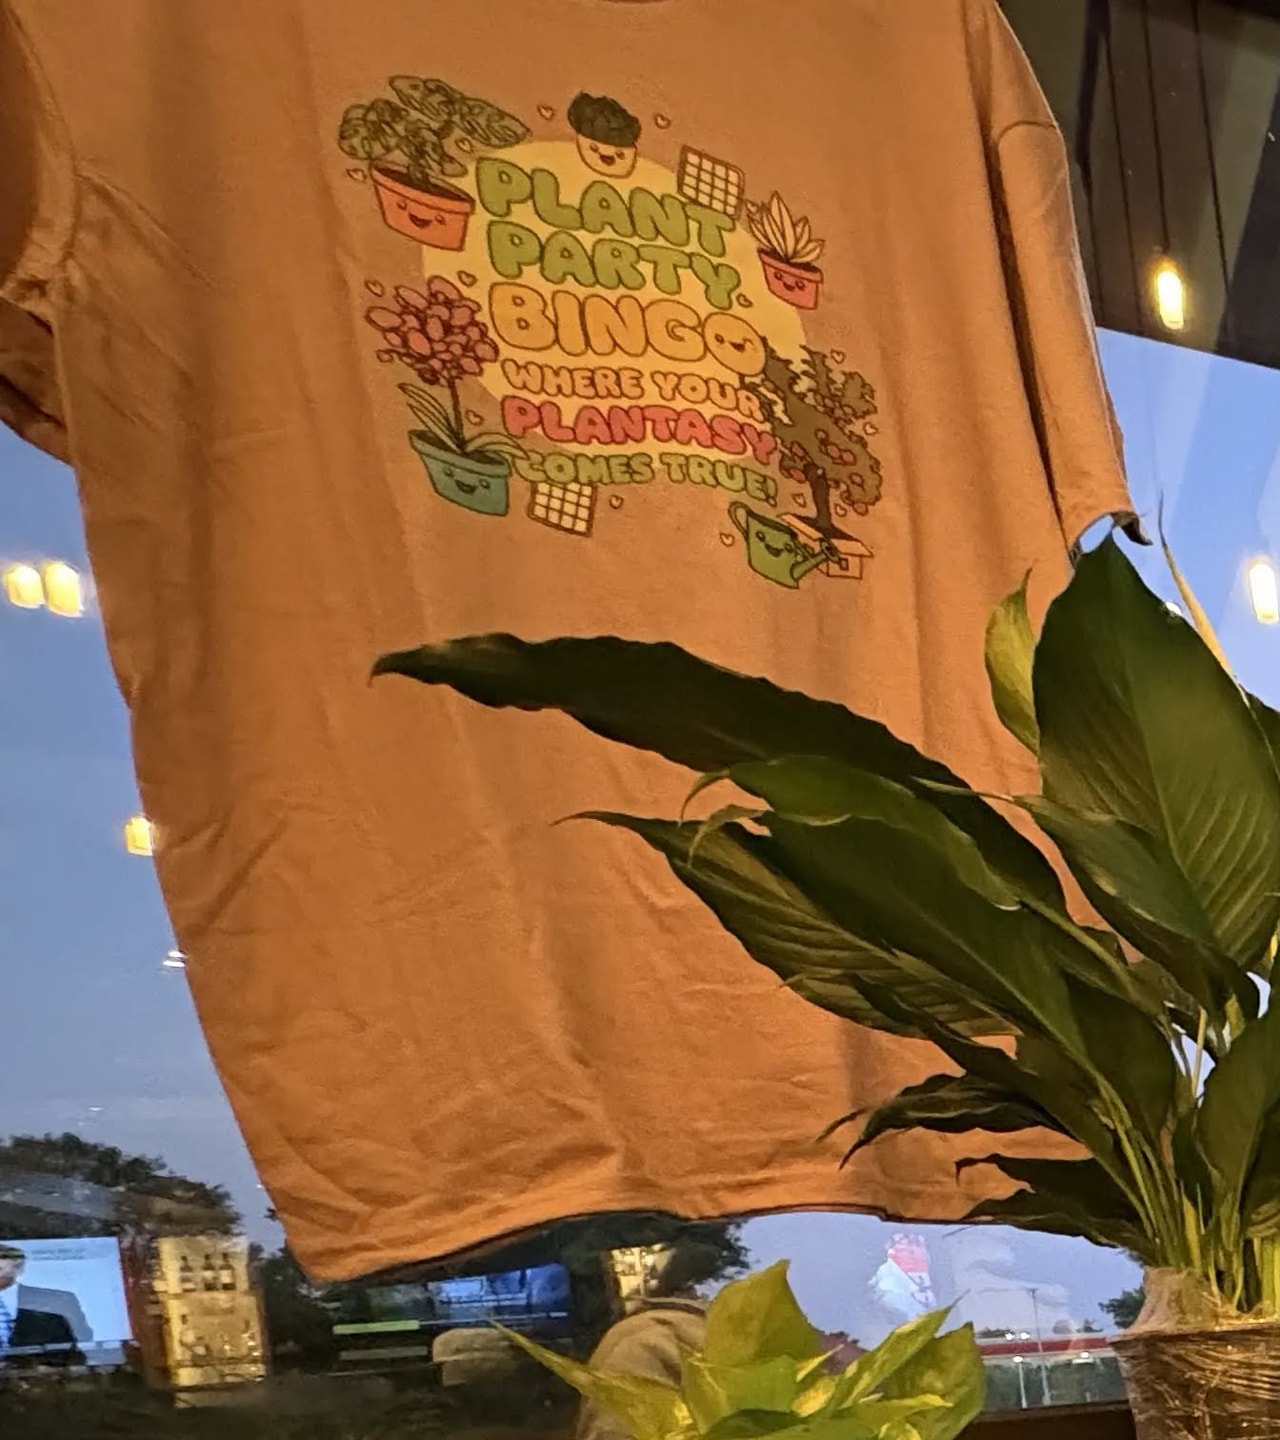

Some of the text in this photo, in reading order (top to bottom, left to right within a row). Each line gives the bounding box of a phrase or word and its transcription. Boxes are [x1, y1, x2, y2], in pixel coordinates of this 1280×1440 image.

[475, 156, 737, 258] PLANT
[487, 220, 741, 310] PARTY
[489, 282, 768, 377] BINGO
[500, 395, 777, 466] PLANTASY
[502, 358, 766, 424] WHERE YOUR
[514, 452, 778, 507] COMES TRUE!
